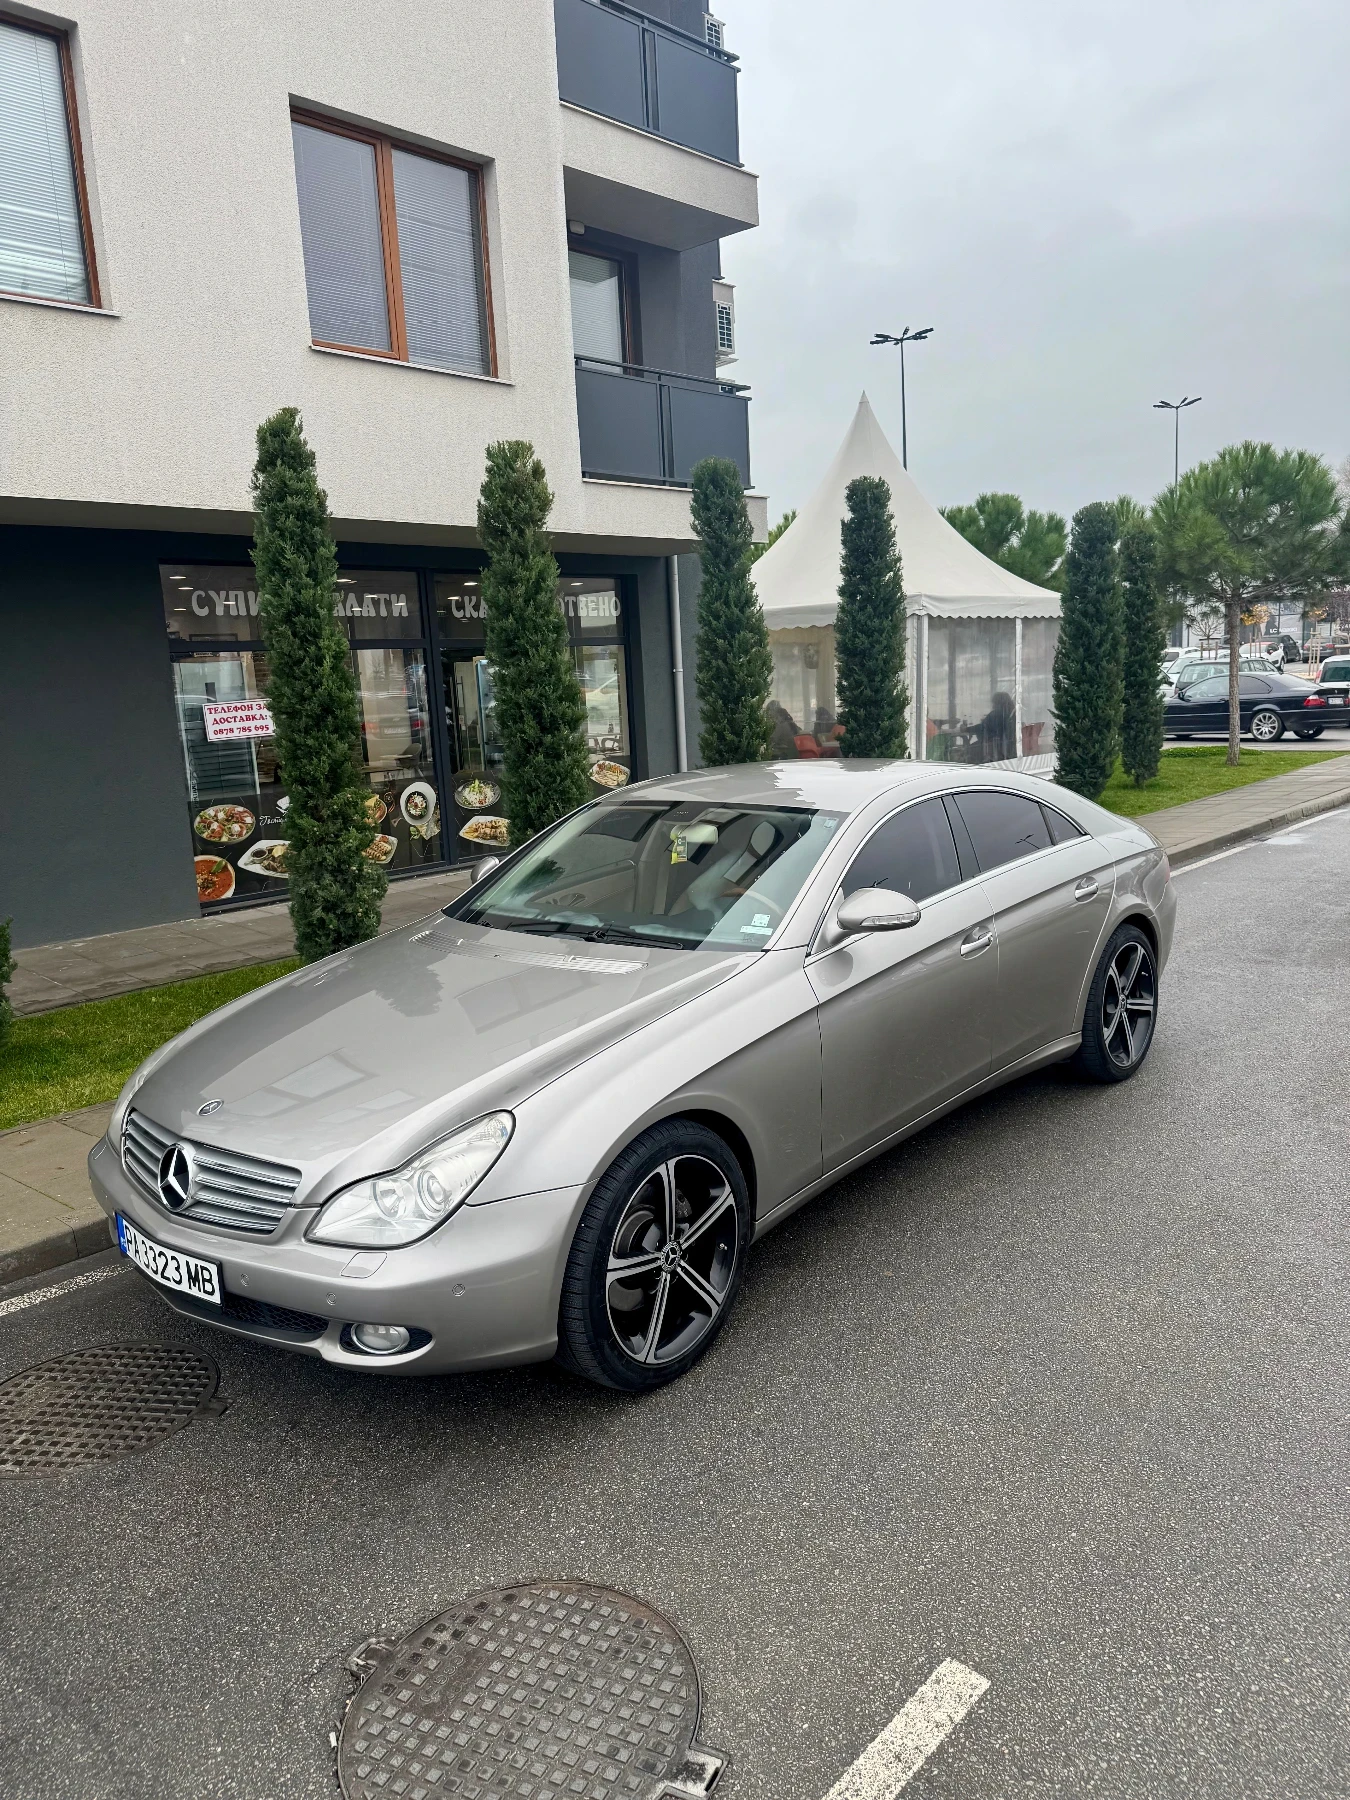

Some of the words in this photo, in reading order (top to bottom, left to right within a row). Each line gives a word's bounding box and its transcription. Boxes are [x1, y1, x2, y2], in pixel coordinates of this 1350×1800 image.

[332, 592, 409, 617] АЛАТИ
[451, 595, 489, 618] СКА
[207, 704, 253, 715] ТЕЛЕФОН
[212, 714, 268, 726] ДОСТАВКА:
[213, 727, 235, 736] 0878
[236, 726, 252, 734] 785
[254, 724, 270, 732] 695
